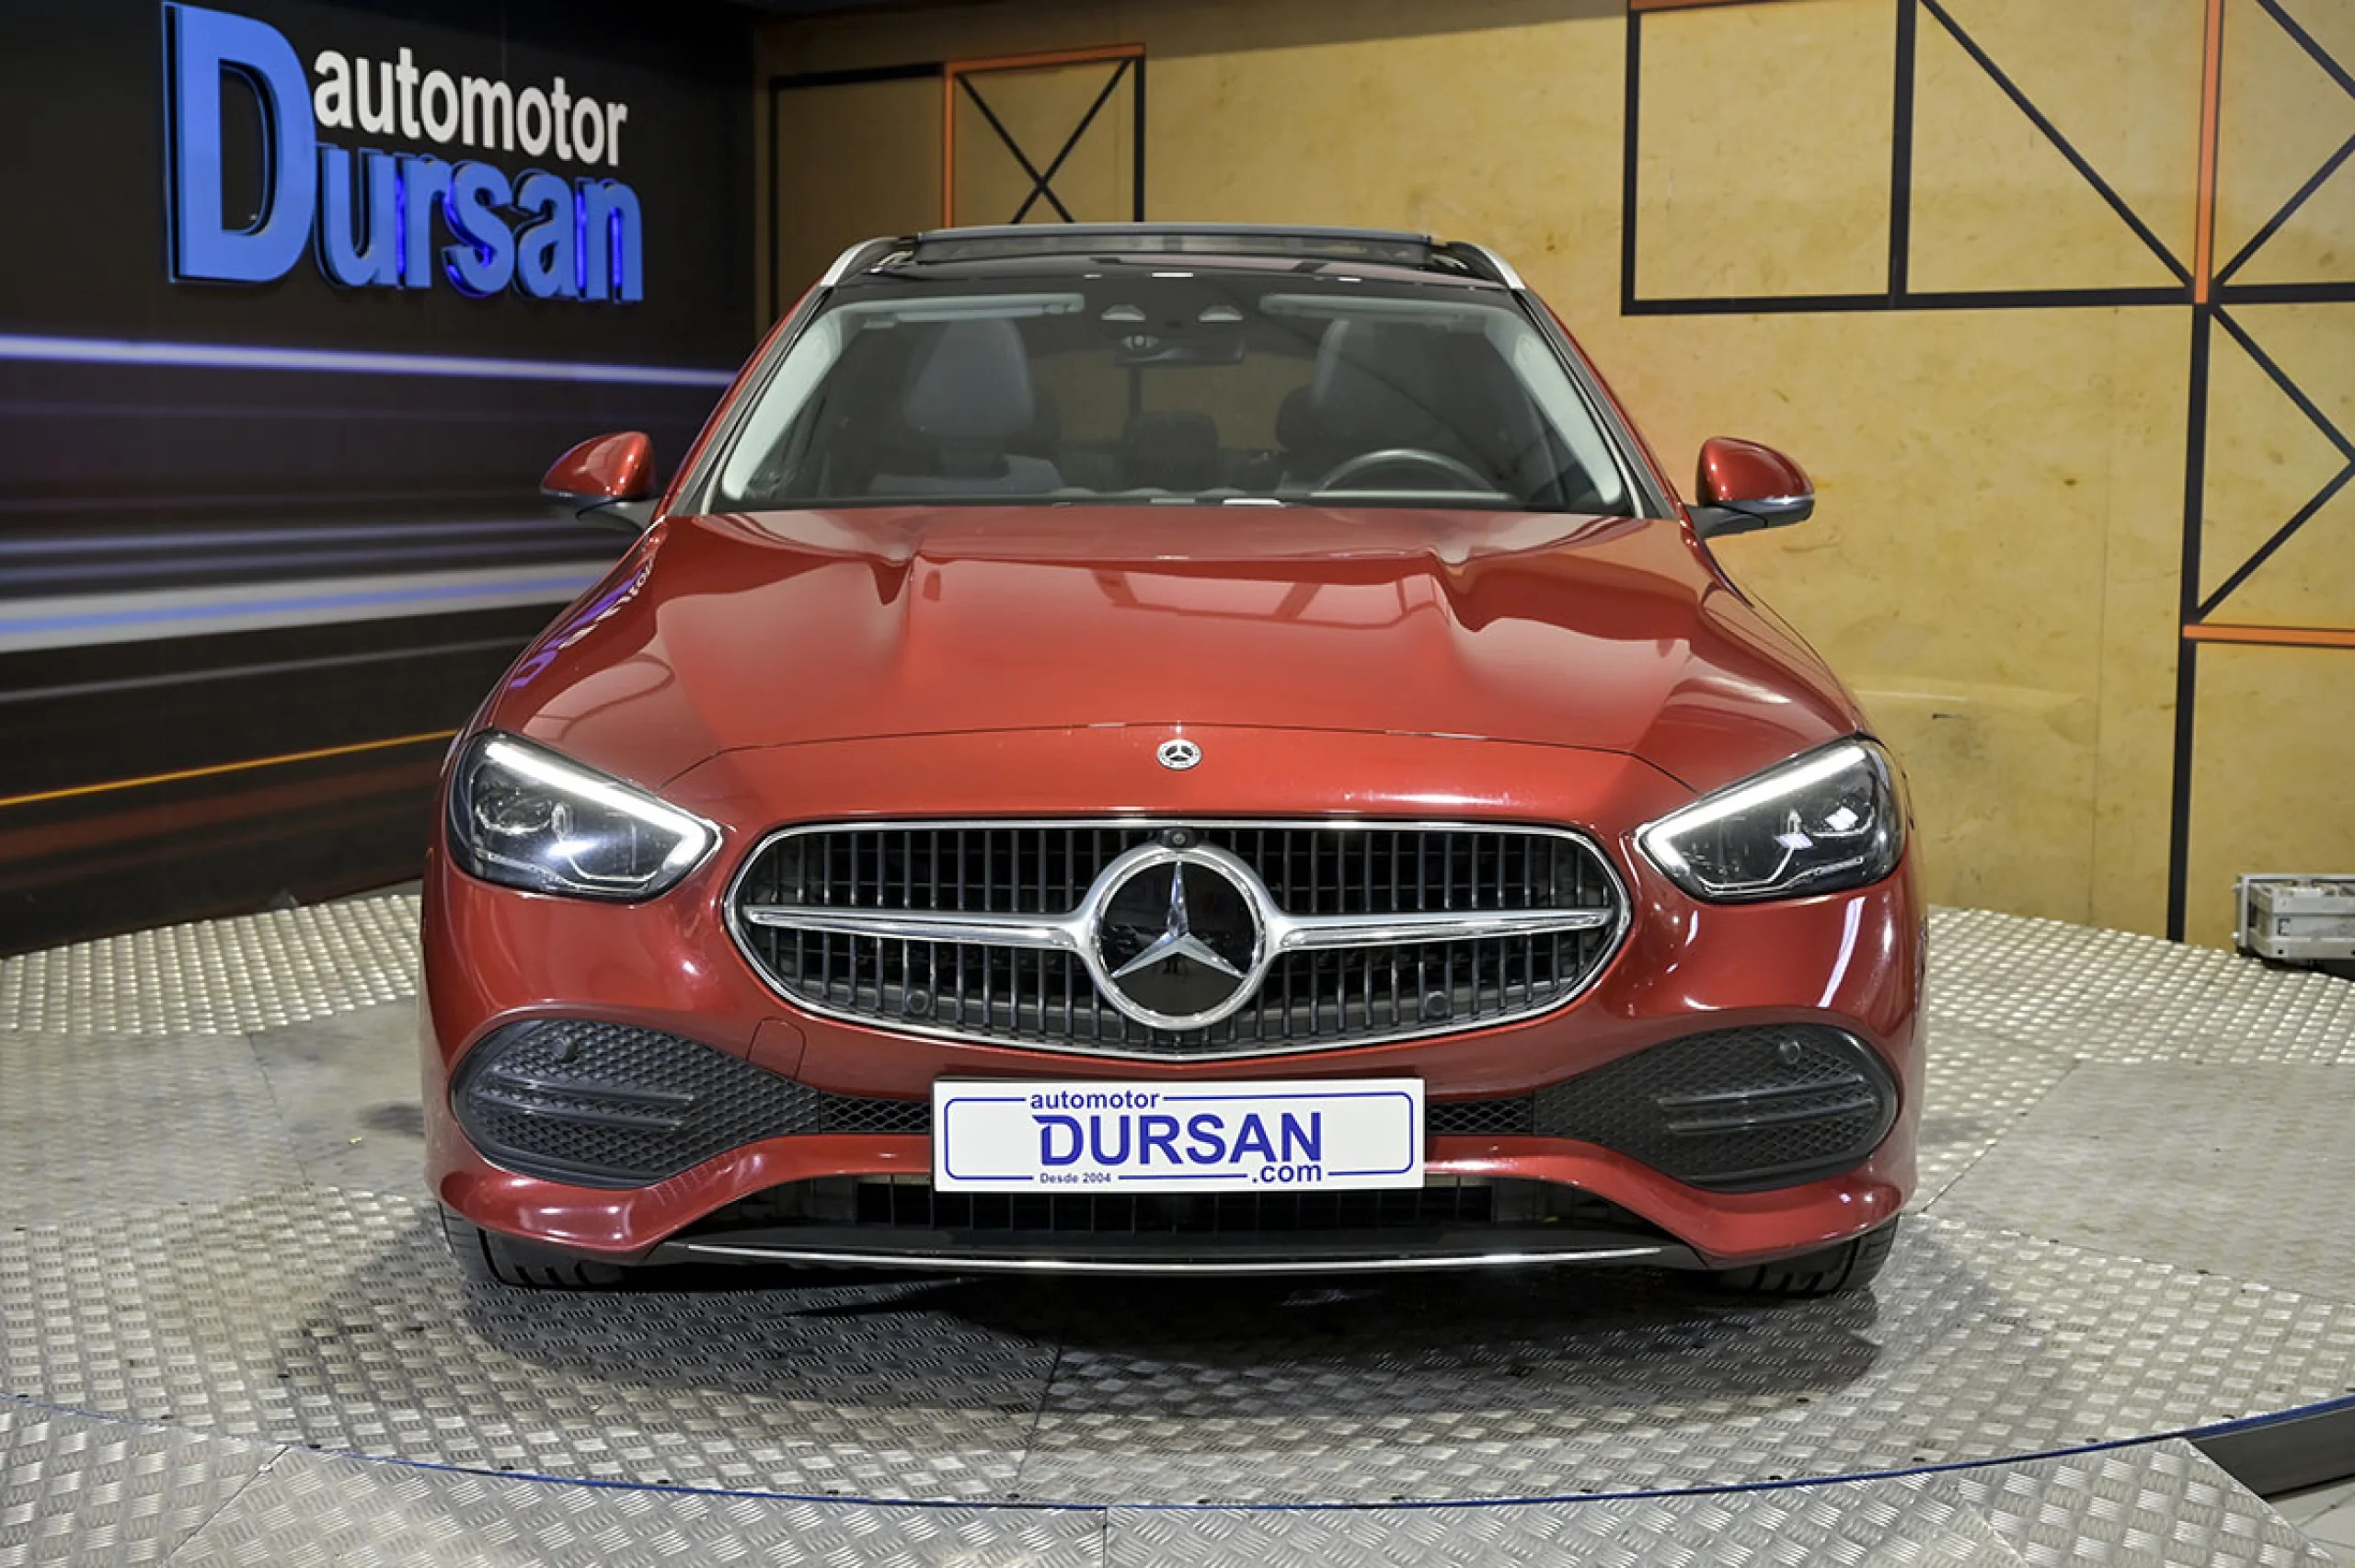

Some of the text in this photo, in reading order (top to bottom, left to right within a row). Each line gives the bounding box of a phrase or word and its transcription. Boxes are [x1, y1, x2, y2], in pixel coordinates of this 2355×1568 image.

[314, 47, 627, 166] automotor
[162, 1, 643, 303] Dursan
[1031, 1091, 1160, 1110] automotor
[1031, 1111, 1322, 1167] DURSAN
[1040, 1172, 1112, 1185] Desde 2004
[1251, 1162, 1322, 1185] .com
